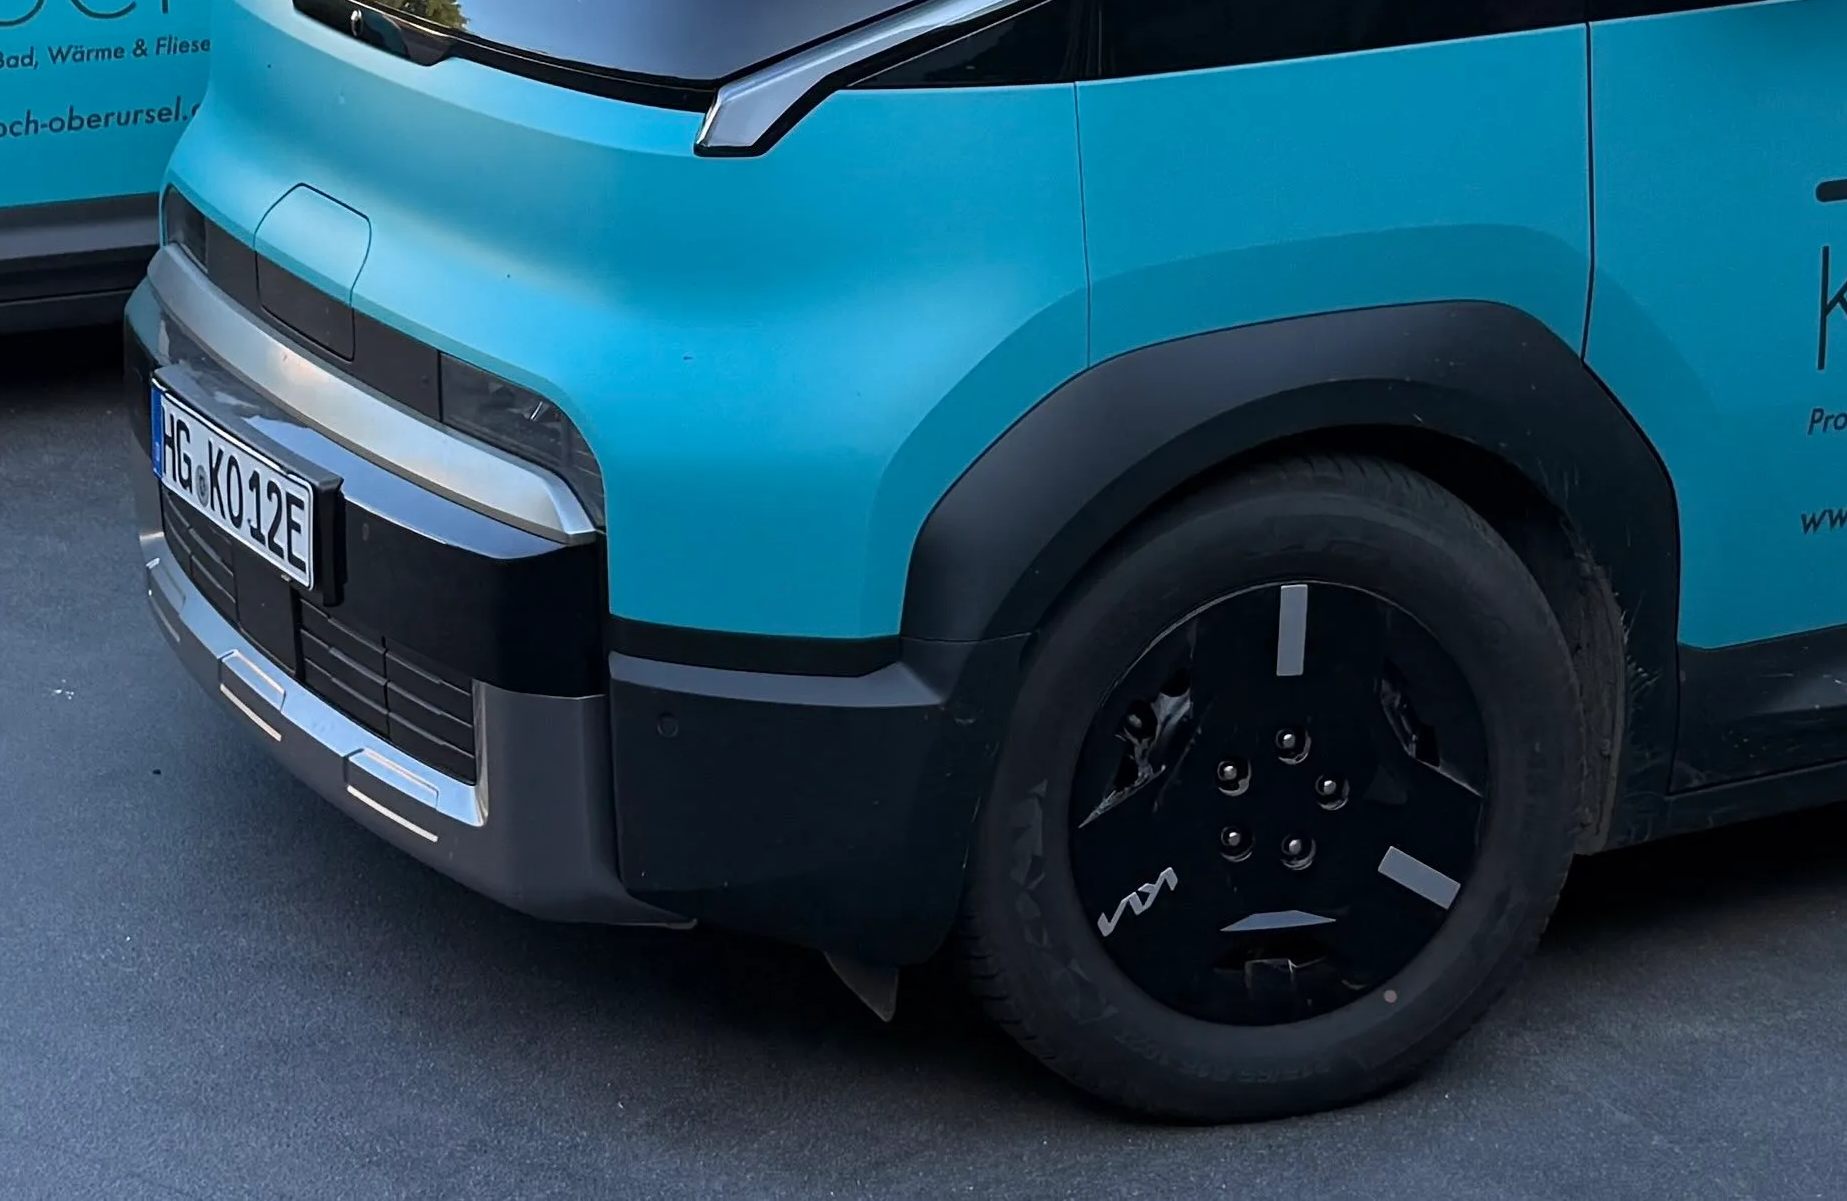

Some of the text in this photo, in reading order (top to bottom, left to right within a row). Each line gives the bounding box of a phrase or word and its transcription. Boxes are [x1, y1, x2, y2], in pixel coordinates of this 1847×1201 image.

[48, 44, 125, 65] Wärme
[132, 38, 149, 58] &
[155, 34, 211, 56] Fliese
[162, 406, 193, 496] HG
